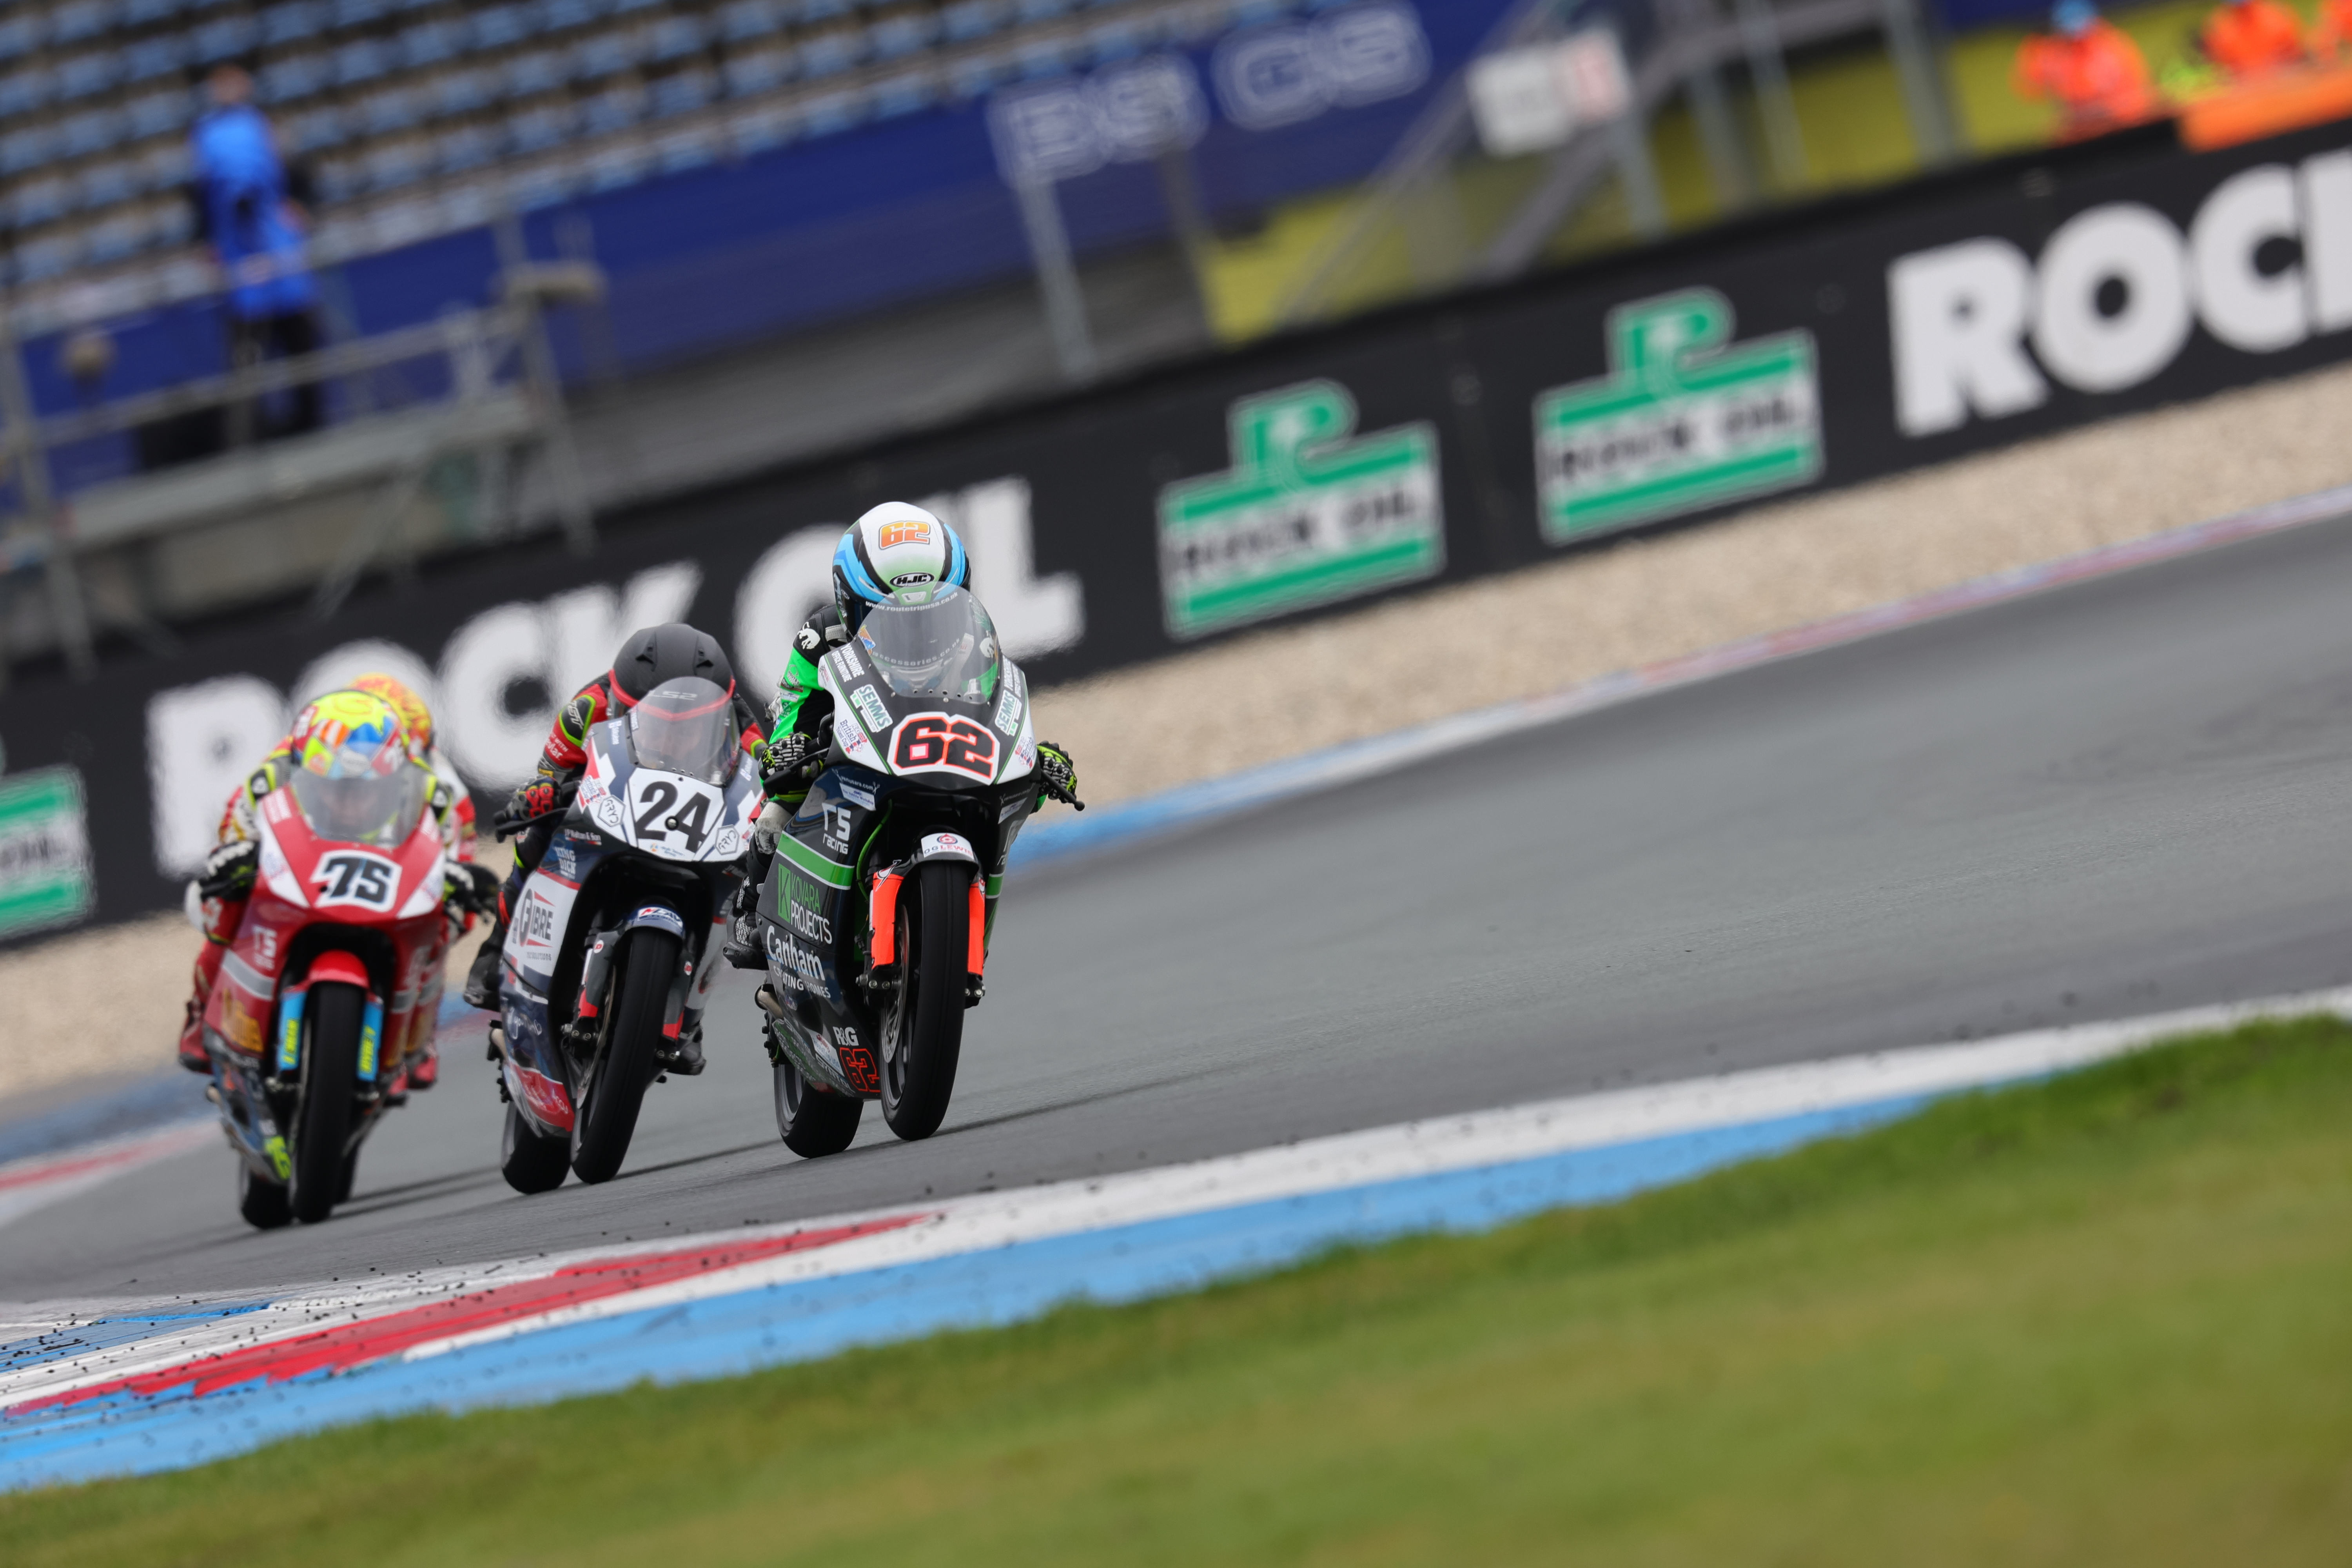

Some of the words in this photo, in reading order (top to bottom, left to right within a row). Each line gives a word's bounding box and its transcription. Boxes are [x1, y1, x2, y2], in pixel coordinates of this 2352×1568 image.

[879, 521, 930, 550] 62
[897, 575, 927, 584] HJC
[866, 592, 958, 612] www.routetripusa.co.uk
[841, 643, 865, 678] YORKSHIRE
[859, 685, 891, 728] SEMMS
[997, 691, 1015, 730] SEMMS
[840, 719, 857, 742] British
[893, 717, 996, 779] 62
[636, 781, 711, 852] 24
[325, 855, 392, 903] 75
[791, 873, 821, 915] KOVARA
[791, 900, 832, 944] PROJECTS
[767, 925, 825, 981] Canham
[805, 981, 831, 998] HOMES
[833, 1027, 859, 1046] R&G
[840, 1047, 880, 1092] 62
